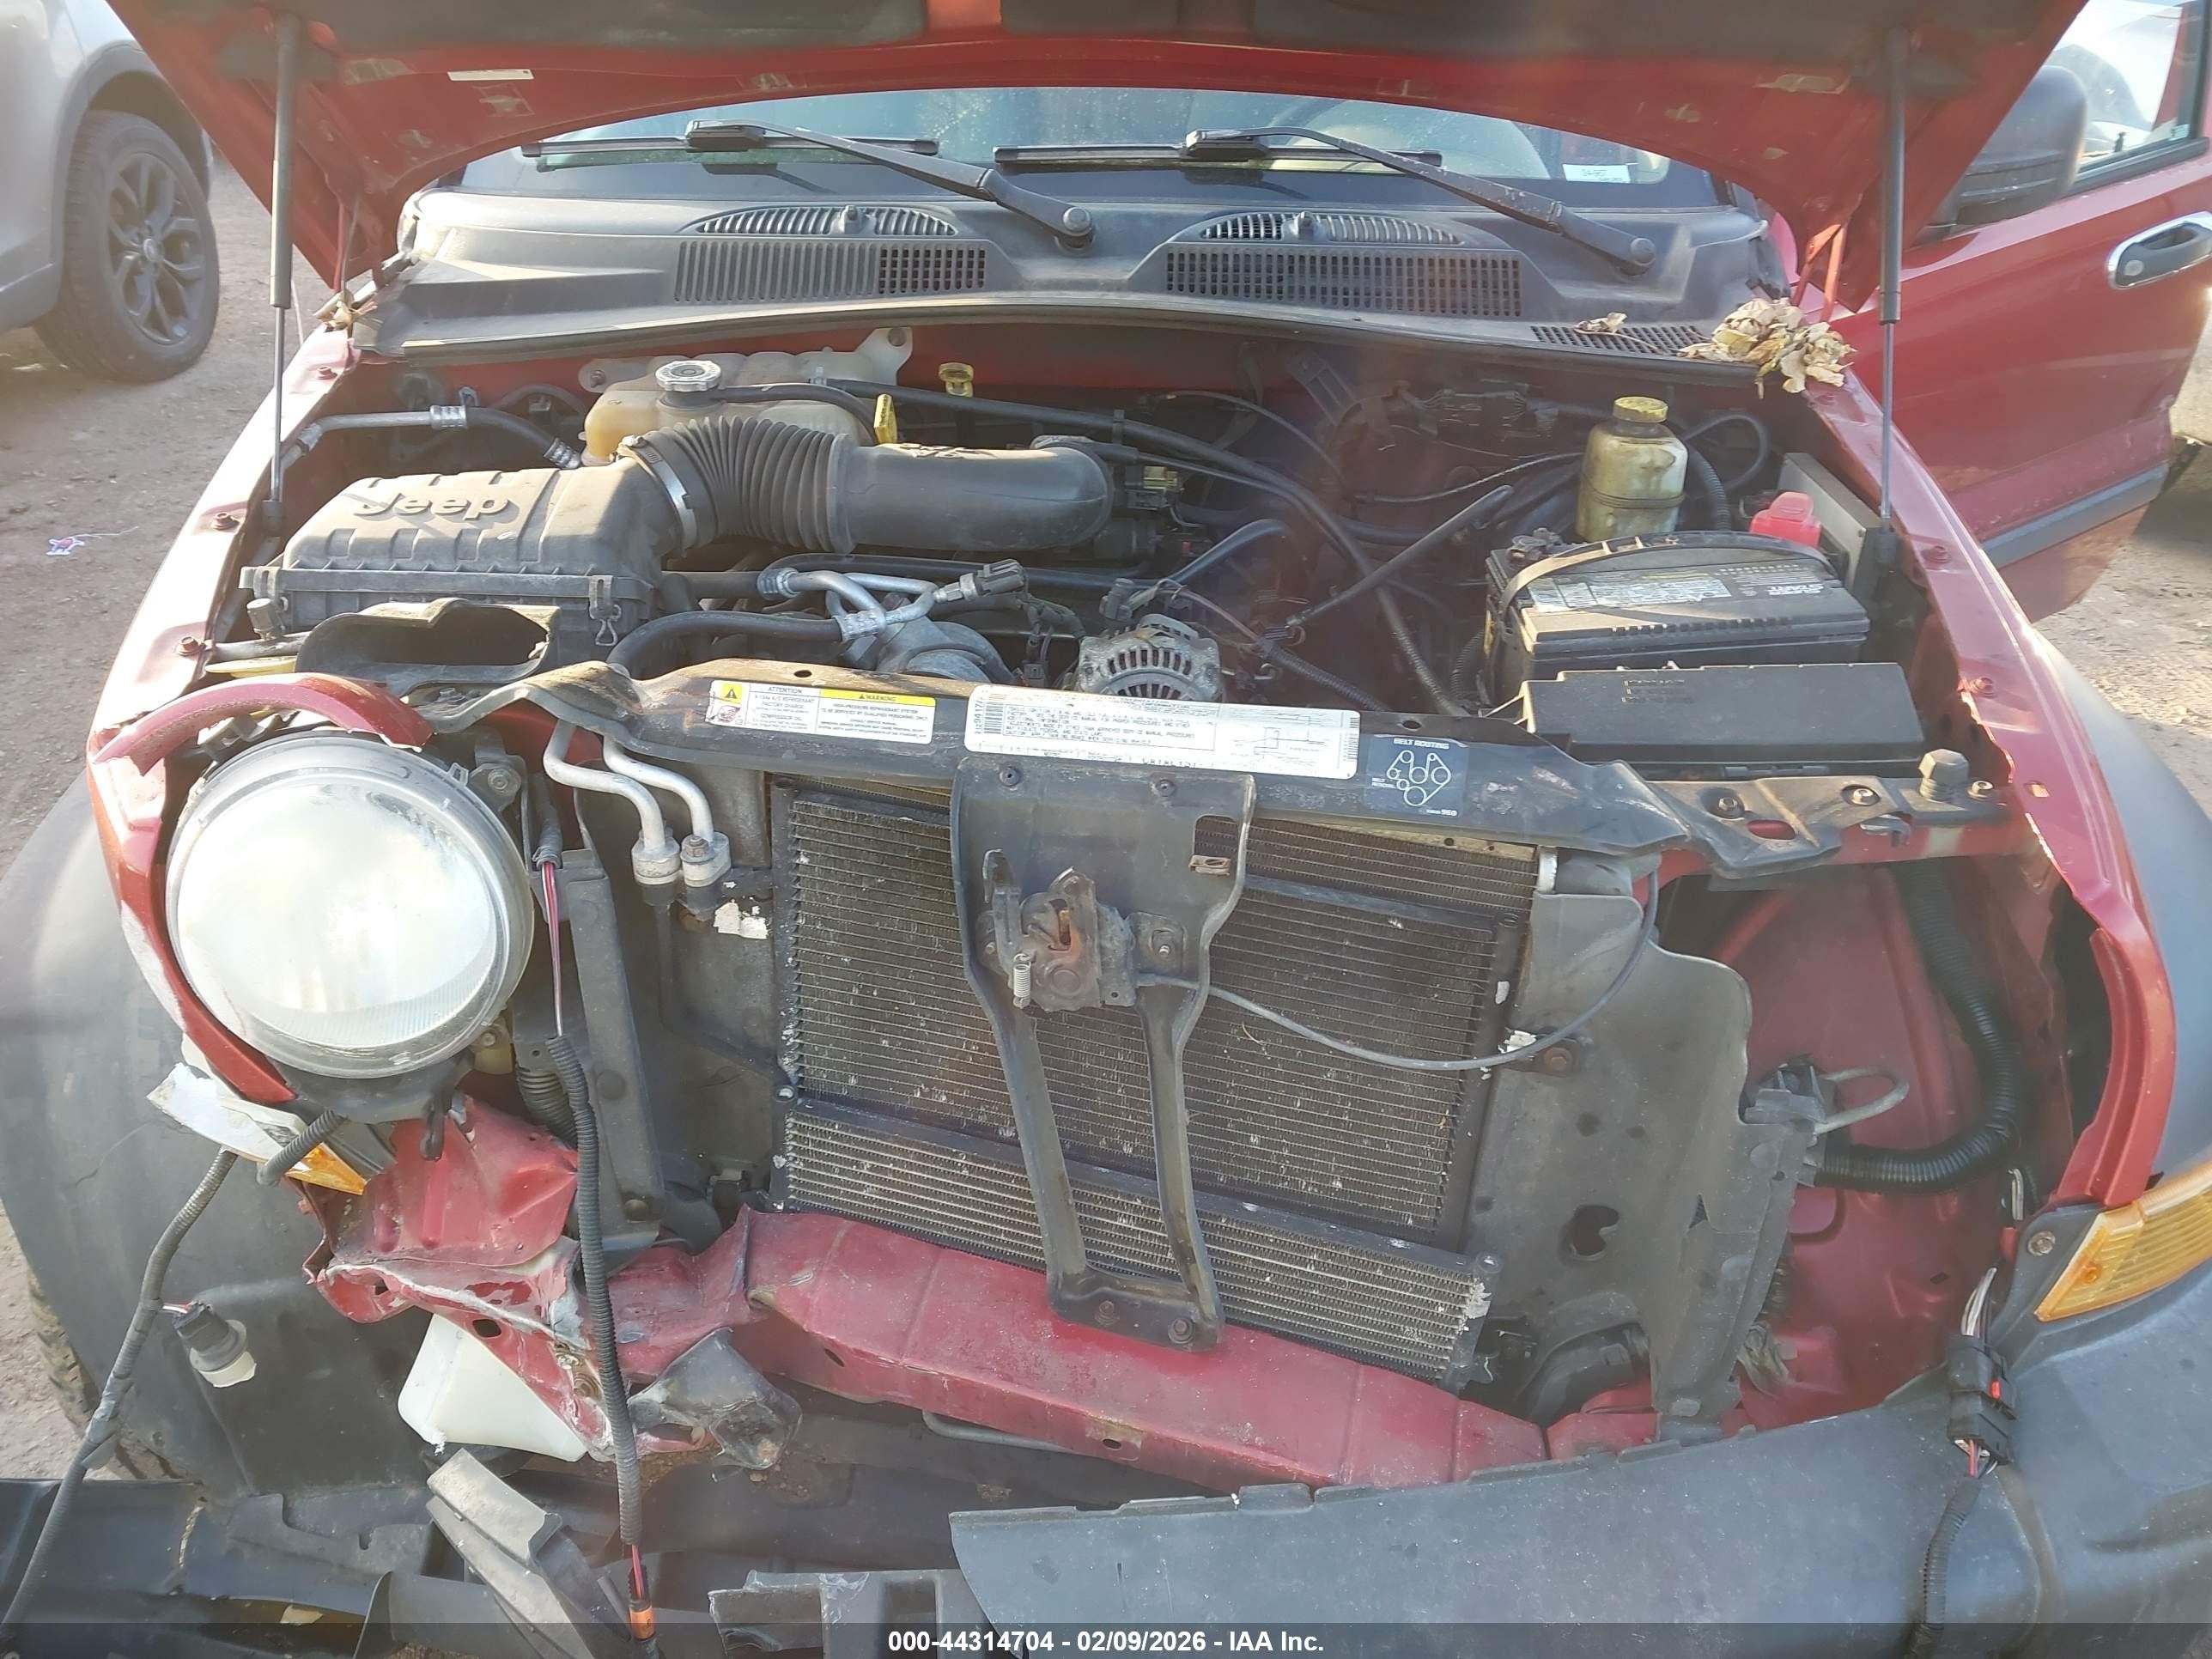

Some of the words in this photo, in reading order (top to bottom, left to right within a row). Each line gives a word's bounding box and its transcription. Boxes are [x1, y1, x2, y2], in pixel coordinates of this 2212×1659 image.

[354, 493, 510, 521] Jeep
[768, 686, 803, 695] ATTENTION
[1414, 739, 1449, 750] ROUTING
